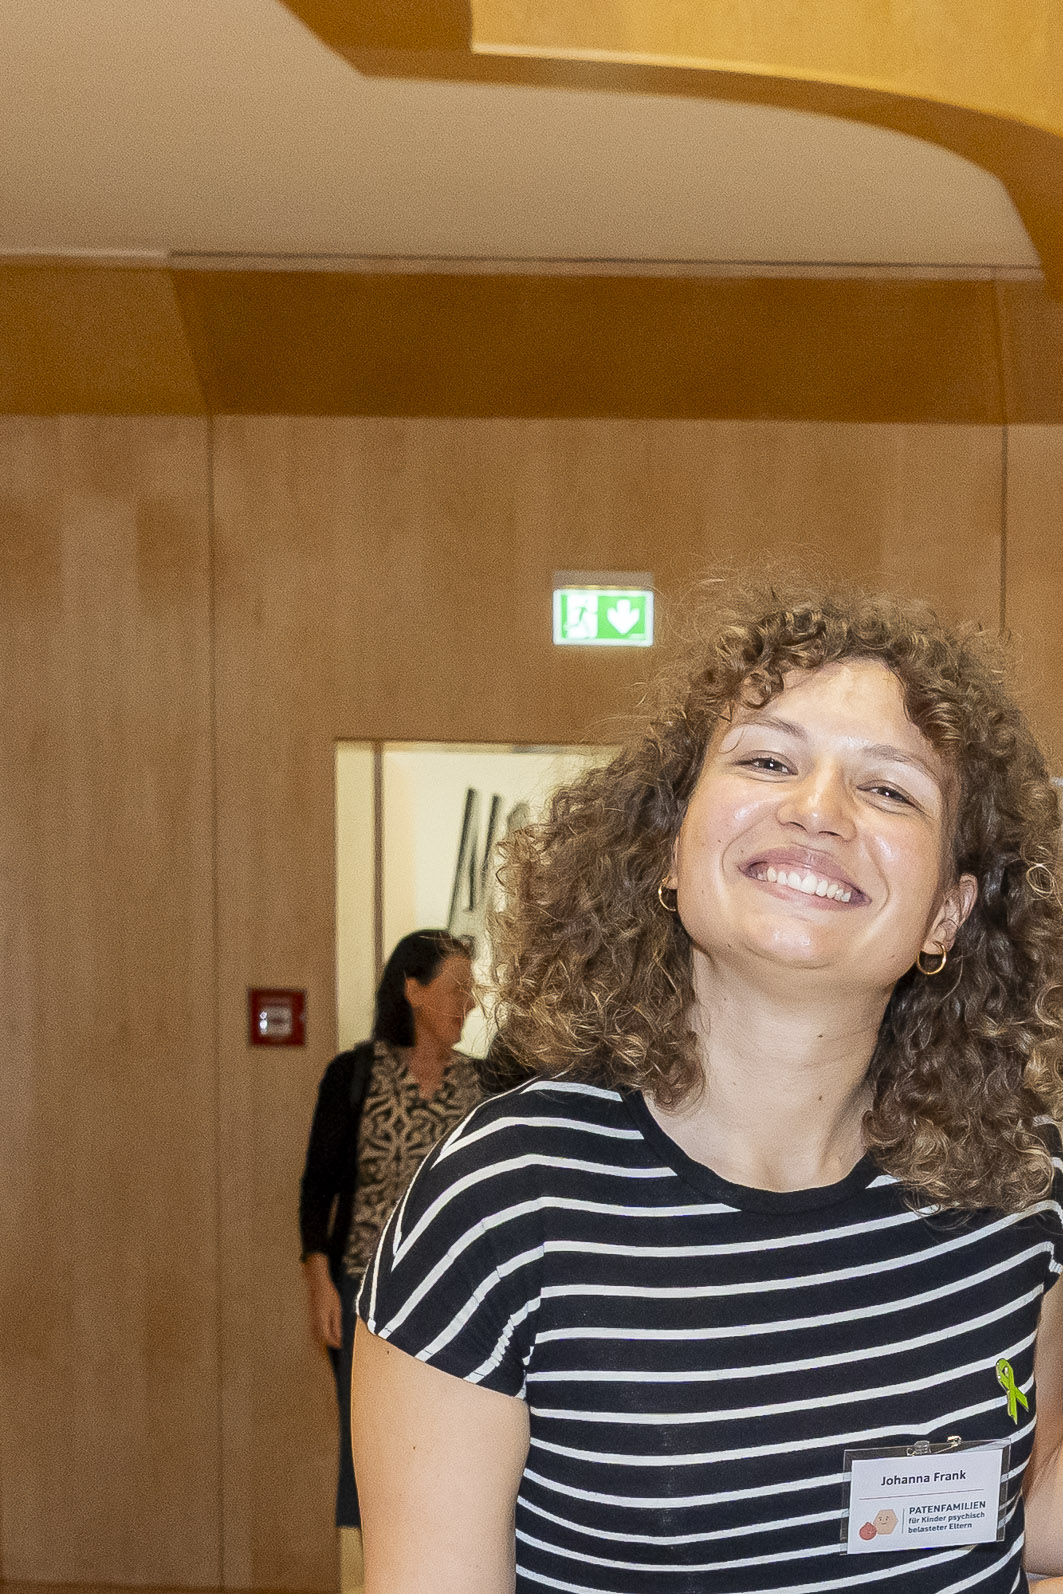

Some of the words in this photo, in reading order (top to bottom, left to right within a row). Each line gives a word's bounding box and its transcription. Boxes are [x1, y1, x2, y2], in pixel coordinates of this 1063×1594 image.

[881, 1474, 930, 1486] Johanna
[933, 1469, 967, 1482] Frank
[909, 1500, 987, 1515] PATENFAMILIEN
[908, 1516, 920, 1525] für
[921, 1515, 946, 1524] Kinder
[947, 1511, 985, 1523] psychisch
[908, 1523, 948, 1534] belasteter
[948, 1522, 973, 1531] Eltern
